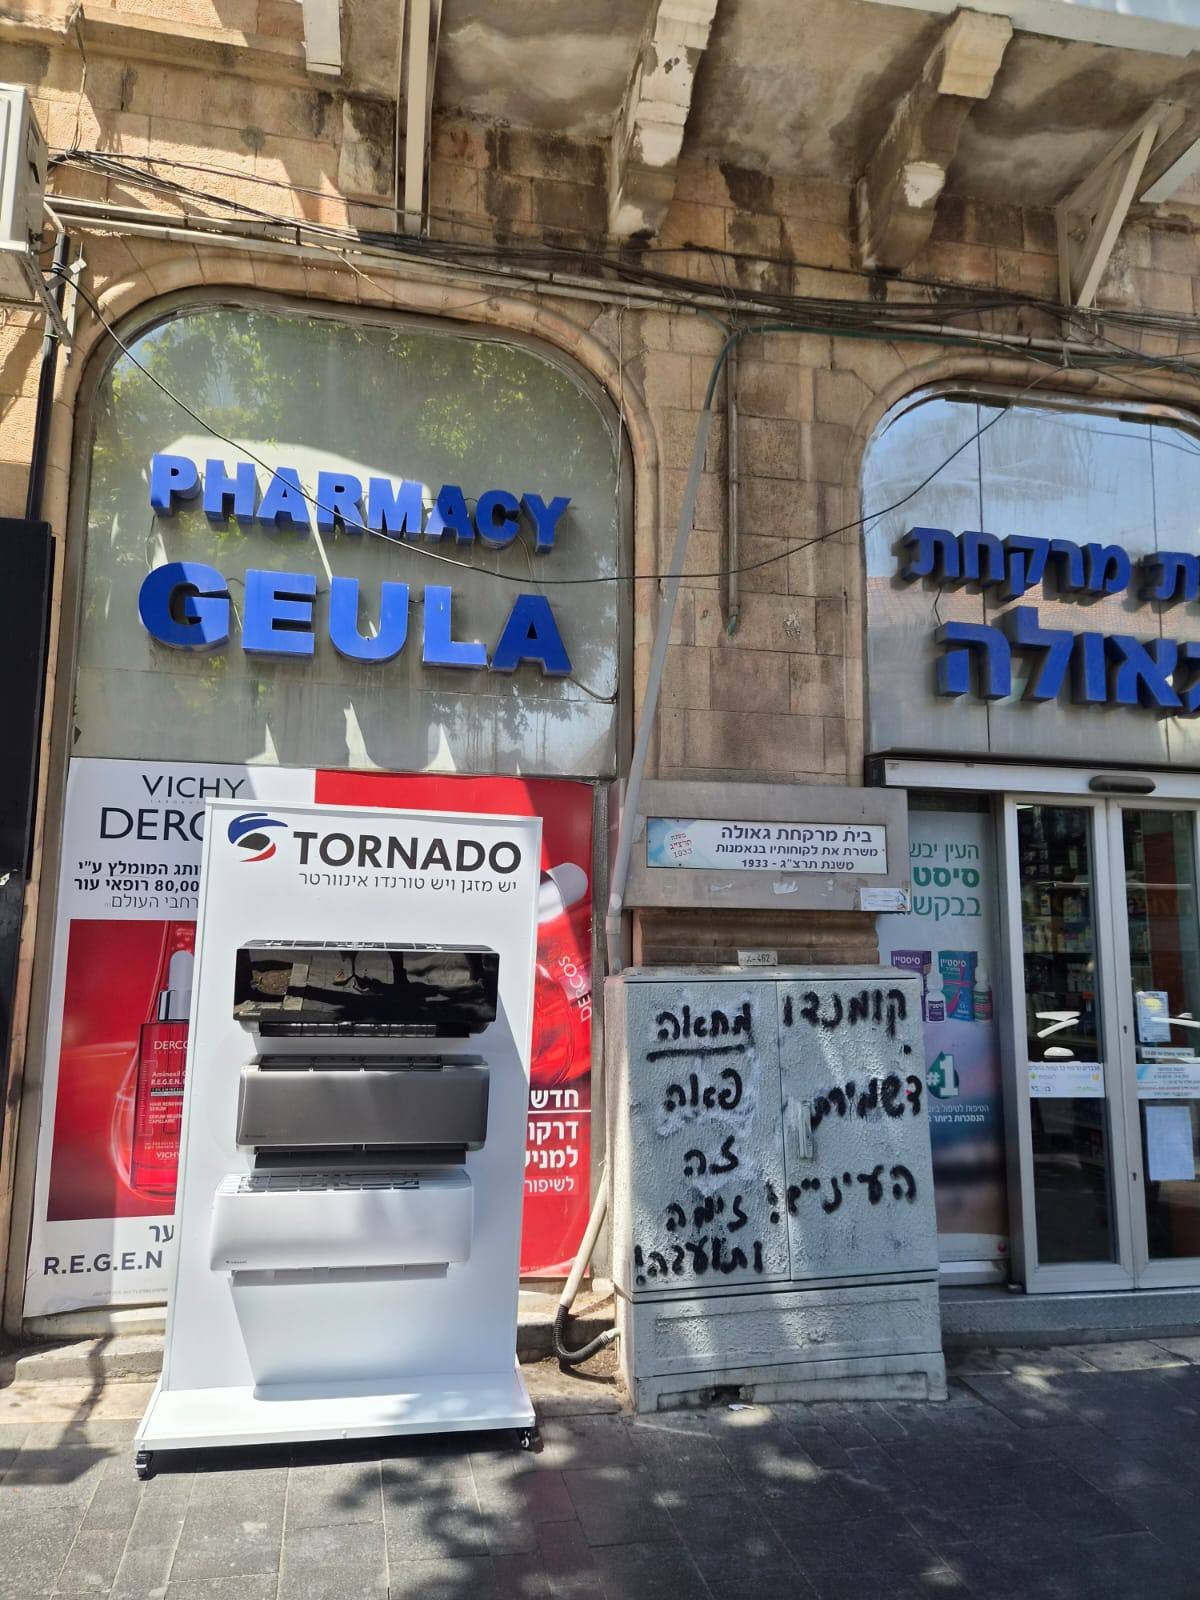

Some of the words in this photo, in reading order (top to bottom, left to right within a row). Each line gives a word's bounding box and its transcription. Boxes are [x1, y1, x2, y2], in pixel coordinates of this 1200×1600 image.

[150, 453, 572, 553] PHARMACY
[901, 527, 1131, 602] מרקחת
[138, 561, 573, 677] GEULA
[142, 774, 246, 798] VICHY
[721, 825, 771, 840] גאולה
[776, 828, 837, 843] מרקחת
[843, 830, 872, 843] בית
[293, 831, 522, 874] TORNADO
[715, 844, 766, 854] בנאמנות
[770, 845, 818, 857] לקוחותיו
[821, 846, 839, 856] את
[843, 846, 878, 857] משרת
[946, 844, 979, 862] העין
[78, 861, 102, 875] ע"י
[108, 861, 168, 877] המומלץ
[173, 864, 201, 876] ותג
[742, 859, 768, 868] 1933
[780, 858, 818, 869] תרצ"ג
[820, 860, 854, 871] משנת
[74, 878, 100, 891] עור
[106, 878, 149, 891] רופאי
[298, 872, 368, 887] אינוורטר
[374, 875, 425, 890] טורנדו
[430, 877, 456, 890] ויש
[913, 867, 980, 887] סיסט
[461, 879, 493, 893] מזגן
[498, 881, 517, 893] יש
[111, 894, 159, 908] העולם
[783, 988, 907, 1040] קומנדו
[927, 1055, 958, 1096] #1
[665, 1067, 742, 1112] פאה
[531, 1089, 578, 1108] חדש
[529, 1121, 578, 1145] דרקו
[684, 1135, 739, 1177] זה
[525, 1175, 575, 1192] לשיפור
[665, 1194, 748, 1233] זימה
[149, 1224, 174, 1243] ער
[43, 1250, 163, 1275] R.E.G.E.N
